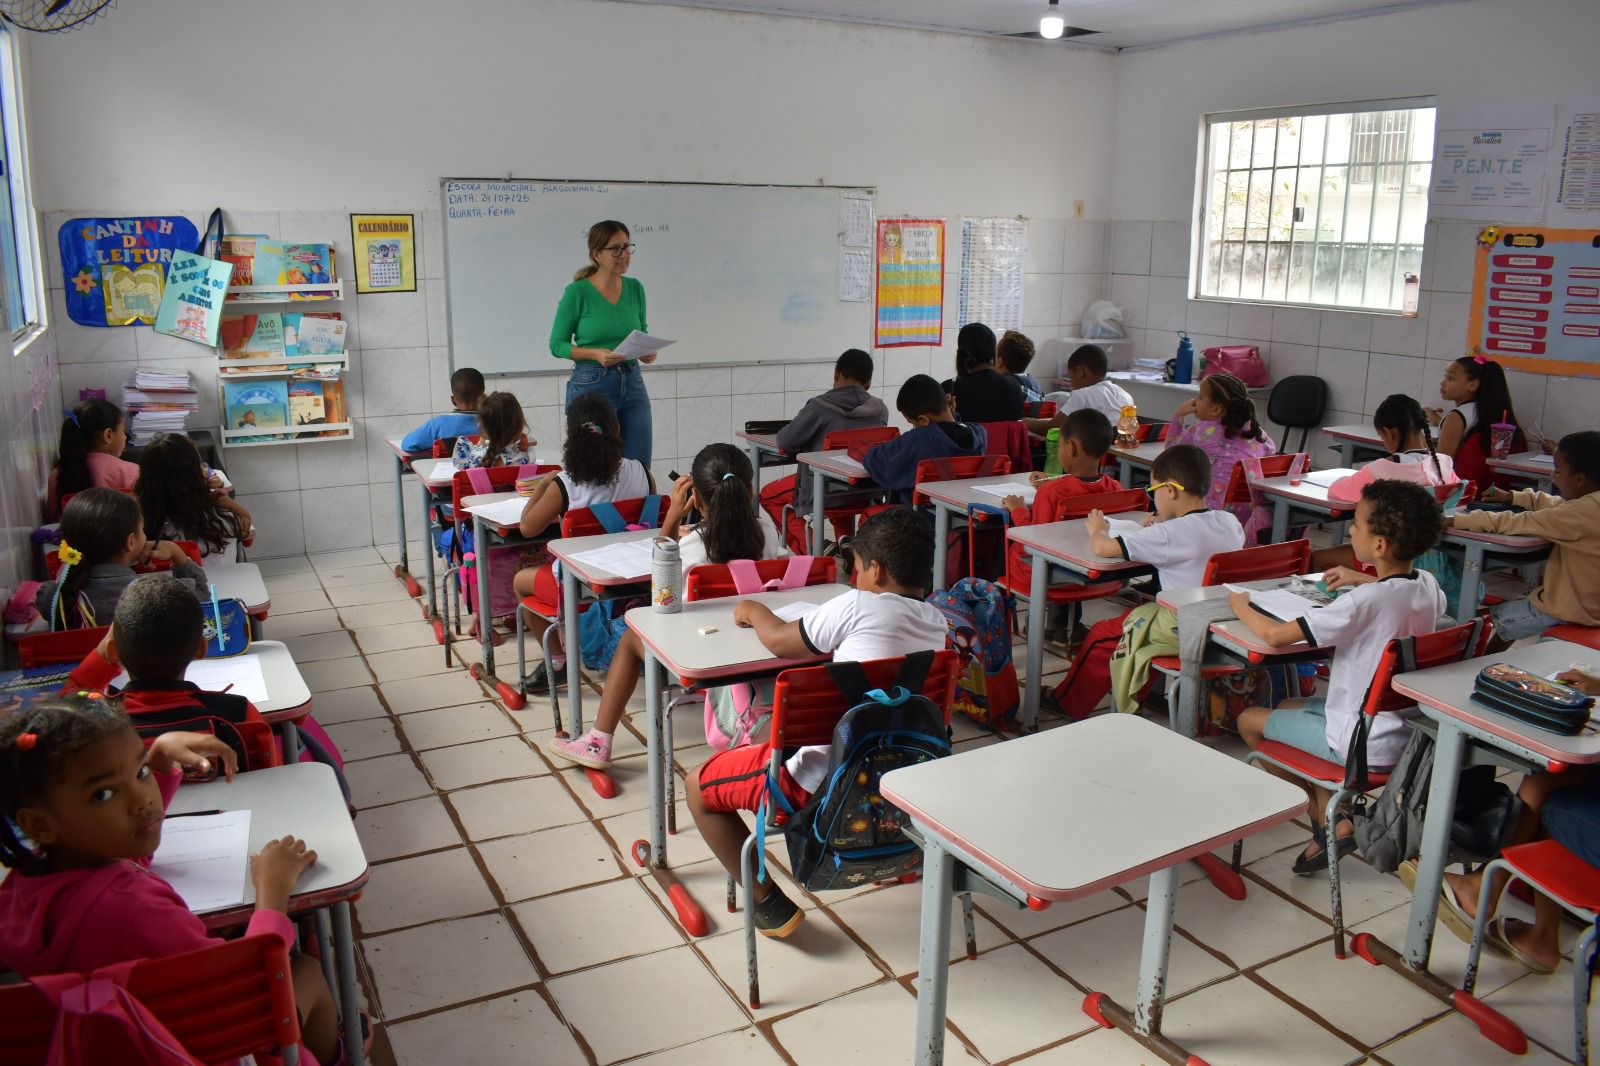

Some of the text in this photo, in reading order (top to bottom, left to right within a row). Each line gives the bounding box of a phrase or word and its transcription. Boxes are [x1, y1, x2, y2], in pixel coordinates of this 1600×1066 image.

[82, 219, 173, 240] CANTINH
[358, 221, 409, 232] CALENDÁRIO
[122, 233, 152, 248] DA
[96, 248, 173, 264] LEITUR
